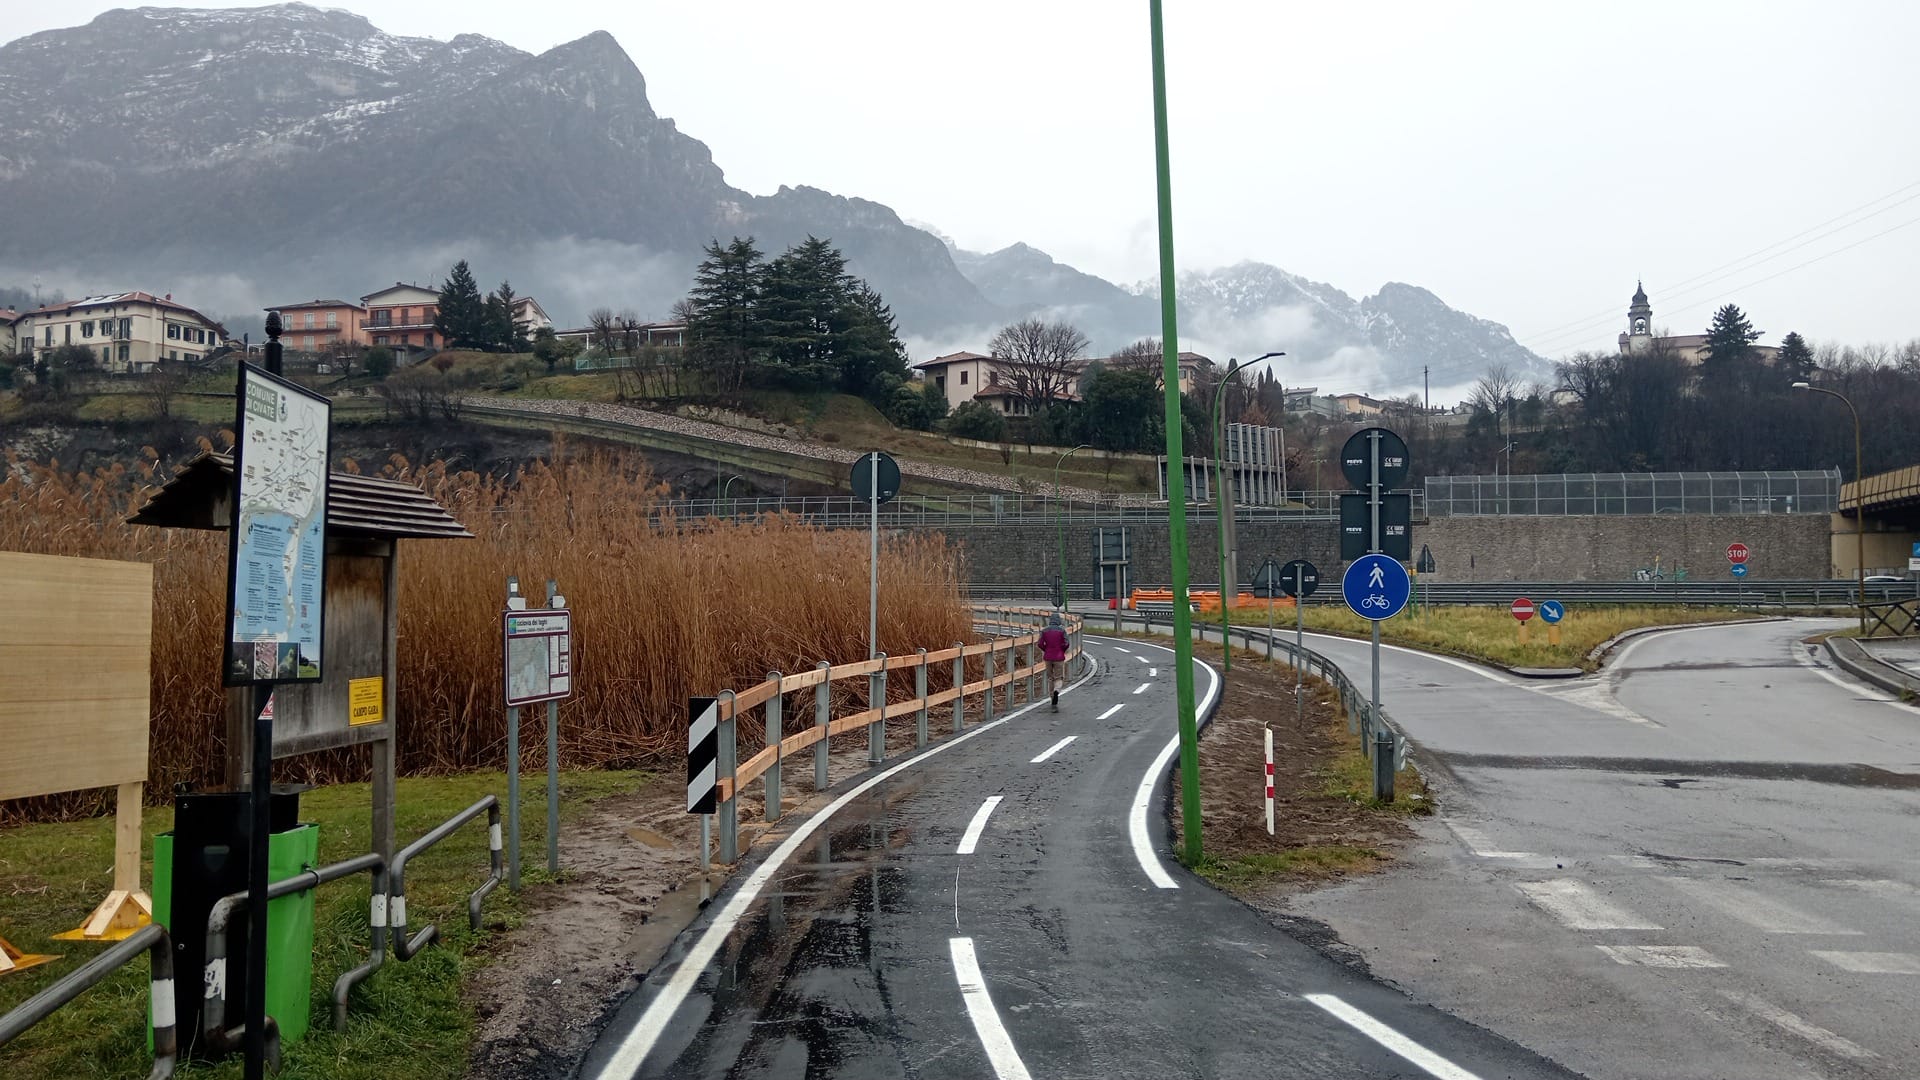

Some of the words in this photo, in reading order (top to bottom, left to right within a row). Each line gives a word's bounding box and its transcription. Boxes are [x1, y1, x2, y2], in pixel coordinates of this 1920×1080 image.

[246, 382, 275, 405] COMUNE
[246, 397, 252, 409] DI
[252, 400, 275, 419] CIVATE
[1727, 550, 1747, 558] STOP
[353, 706, 367, 717] CAMPO
[368, 705, 378, 715] GARA
